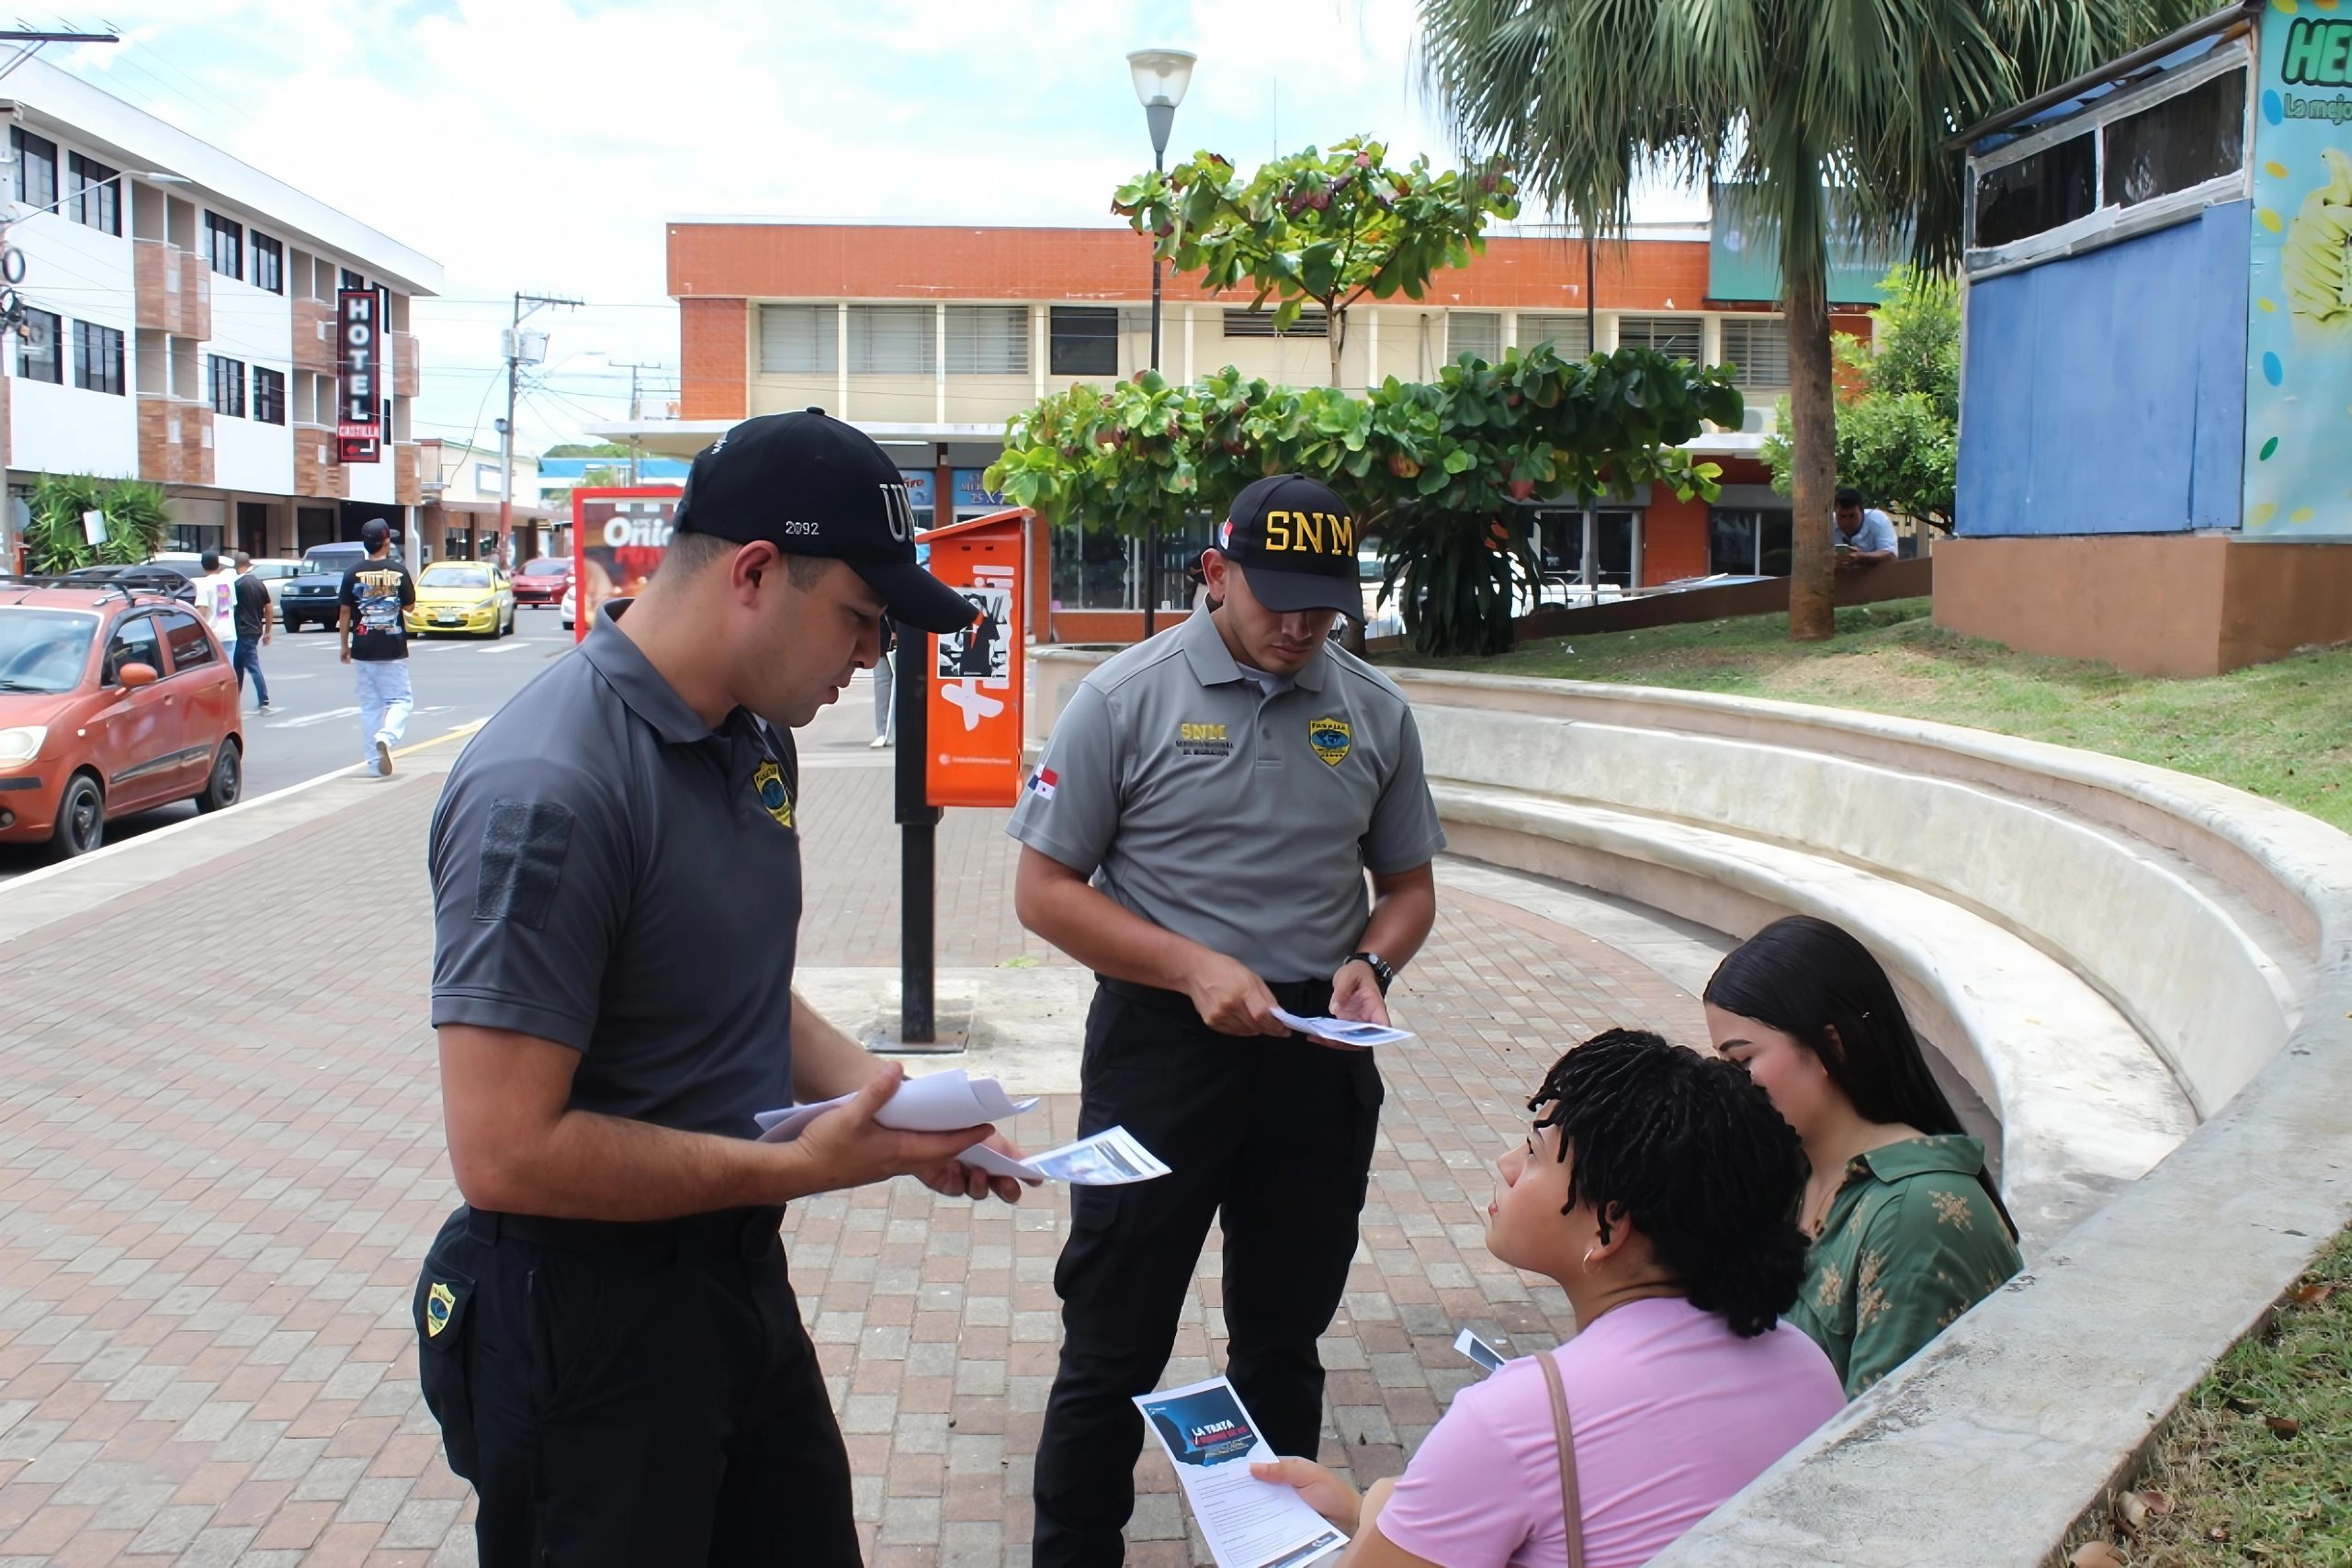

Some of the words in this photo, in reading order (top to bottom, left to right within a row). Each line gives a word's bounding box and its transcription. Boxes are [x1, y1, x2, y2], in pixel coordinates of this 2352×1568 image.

[348, 299, 369, 421] HOTEL
[786, 521, 820, 535] 2092
[1266, 511, 1352, 557] SNM
[1181, 723, 1227, 740] SNM
